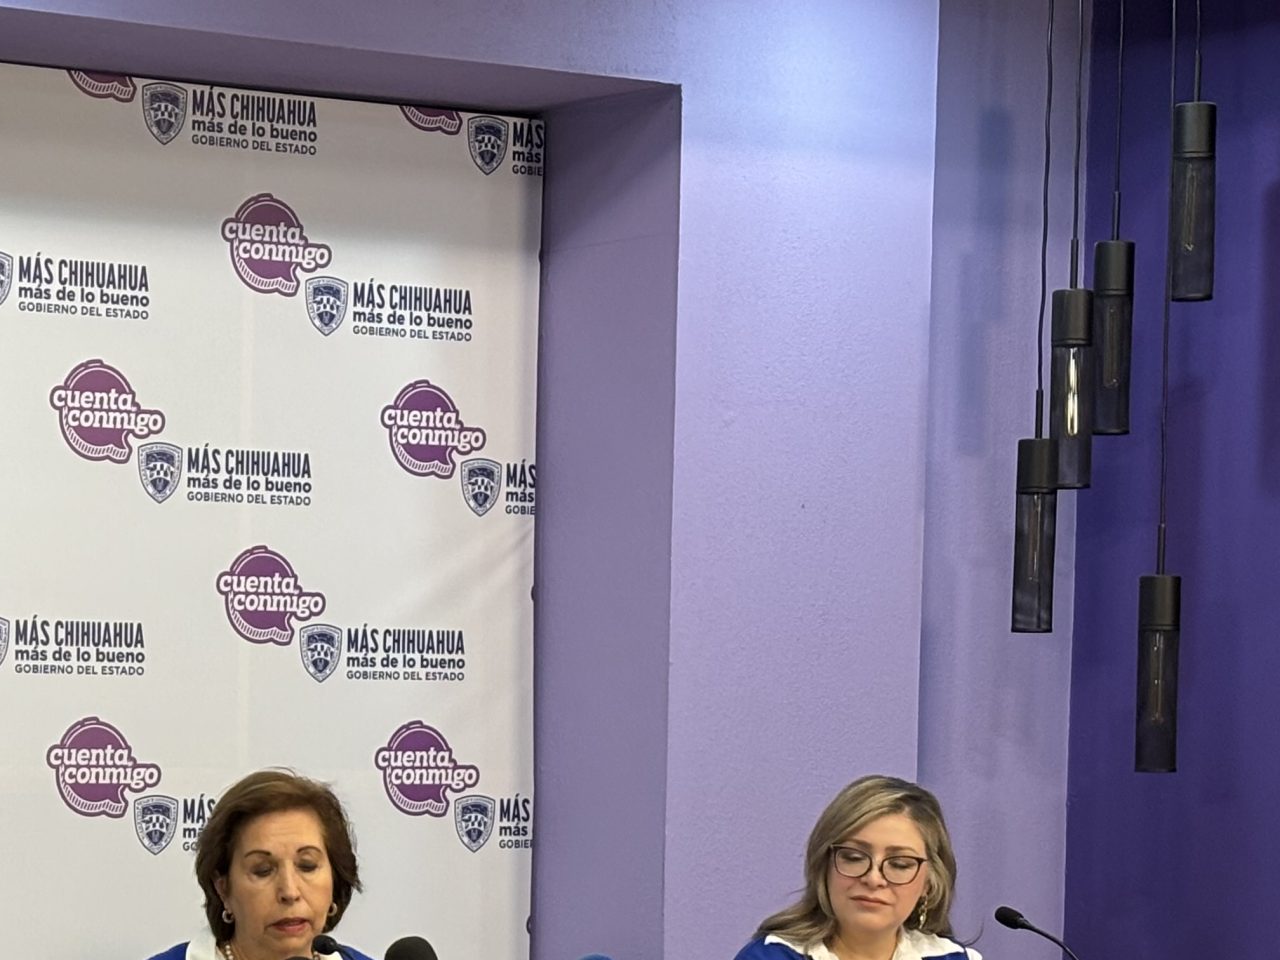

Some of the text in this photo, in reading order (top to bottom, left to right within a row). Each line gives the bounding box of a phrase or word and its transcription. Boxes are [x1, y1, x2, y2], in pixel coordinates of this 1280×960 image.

[224, 222, 300, 244] cuenta
[239, 240, 328, 269] conmigo
[19, 252, 53, 284] MÁS
[58, 259, 148, 292] CHIHUAHUA
[19, 284, 149, 307] más de lo bueno
[19, 302, 148, 320] GOBIERNO DEL ESTADO
[53, 388, 132, 410] cuenta
[68, 407, 162, 435] conmigo
[383, 407, 455, 428] cuenta
[397, 425, 483, 452] conmigo
[219, 573, 294, 594] cuenta
[233, 590, 322, 617] conmigo
[347, 623, 464, 655] MÁS CHIHUAHUA
[347, 654, 465, 669] más de lo bueno
[346, 670, 464, 681] GOBIERNO DEL ESTADO
[49, 744, 128, 765] cuenta
[377, 747, 449, 767] cuenta
[64, 761, 158, 789] conmigo
[391, 763, 476, 789] conmigo
